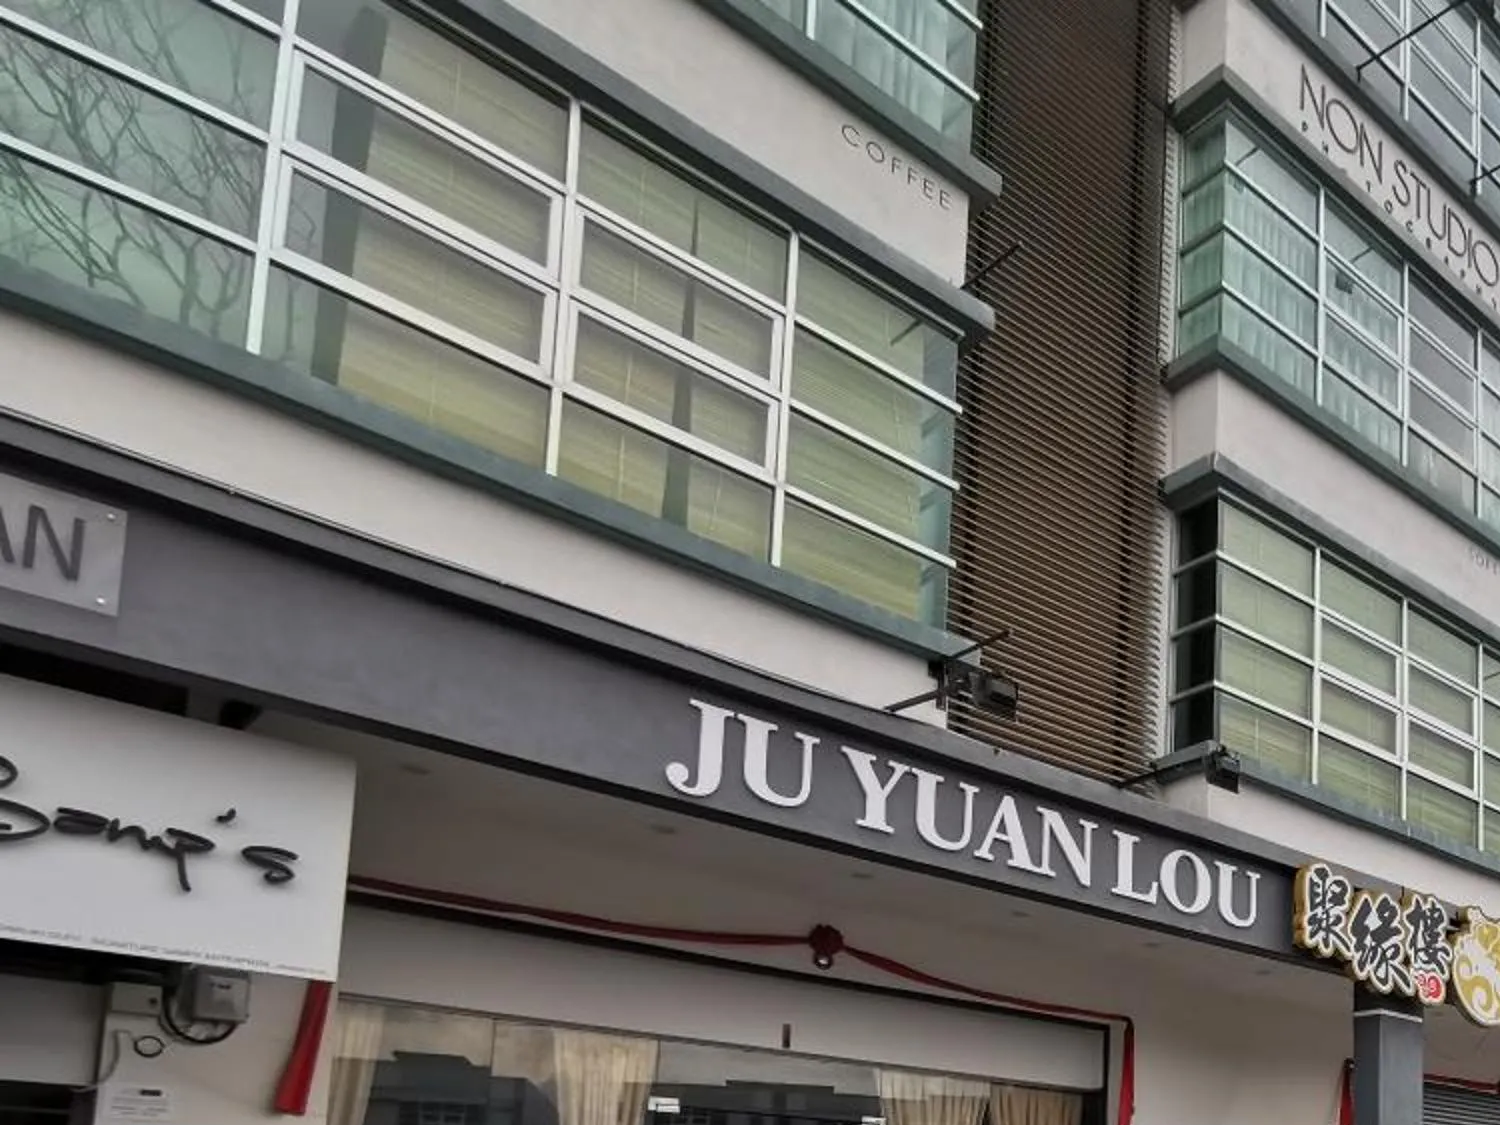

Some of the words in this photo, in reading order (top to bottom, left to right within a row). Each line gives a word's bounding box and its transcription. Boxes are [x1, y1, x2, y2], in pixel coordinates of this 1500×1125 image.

[841, 124, 954, 211] COFFEE
[1300, 62, 1384, 185] NON
[1391, 159, 1500, 288] STUDIO
[0, 500, 87, 583] N
[664, 698, 821, 808] JU
[840, 745, 1098, 888] YUAN
[1110, 829, 1262, 929] LOU
